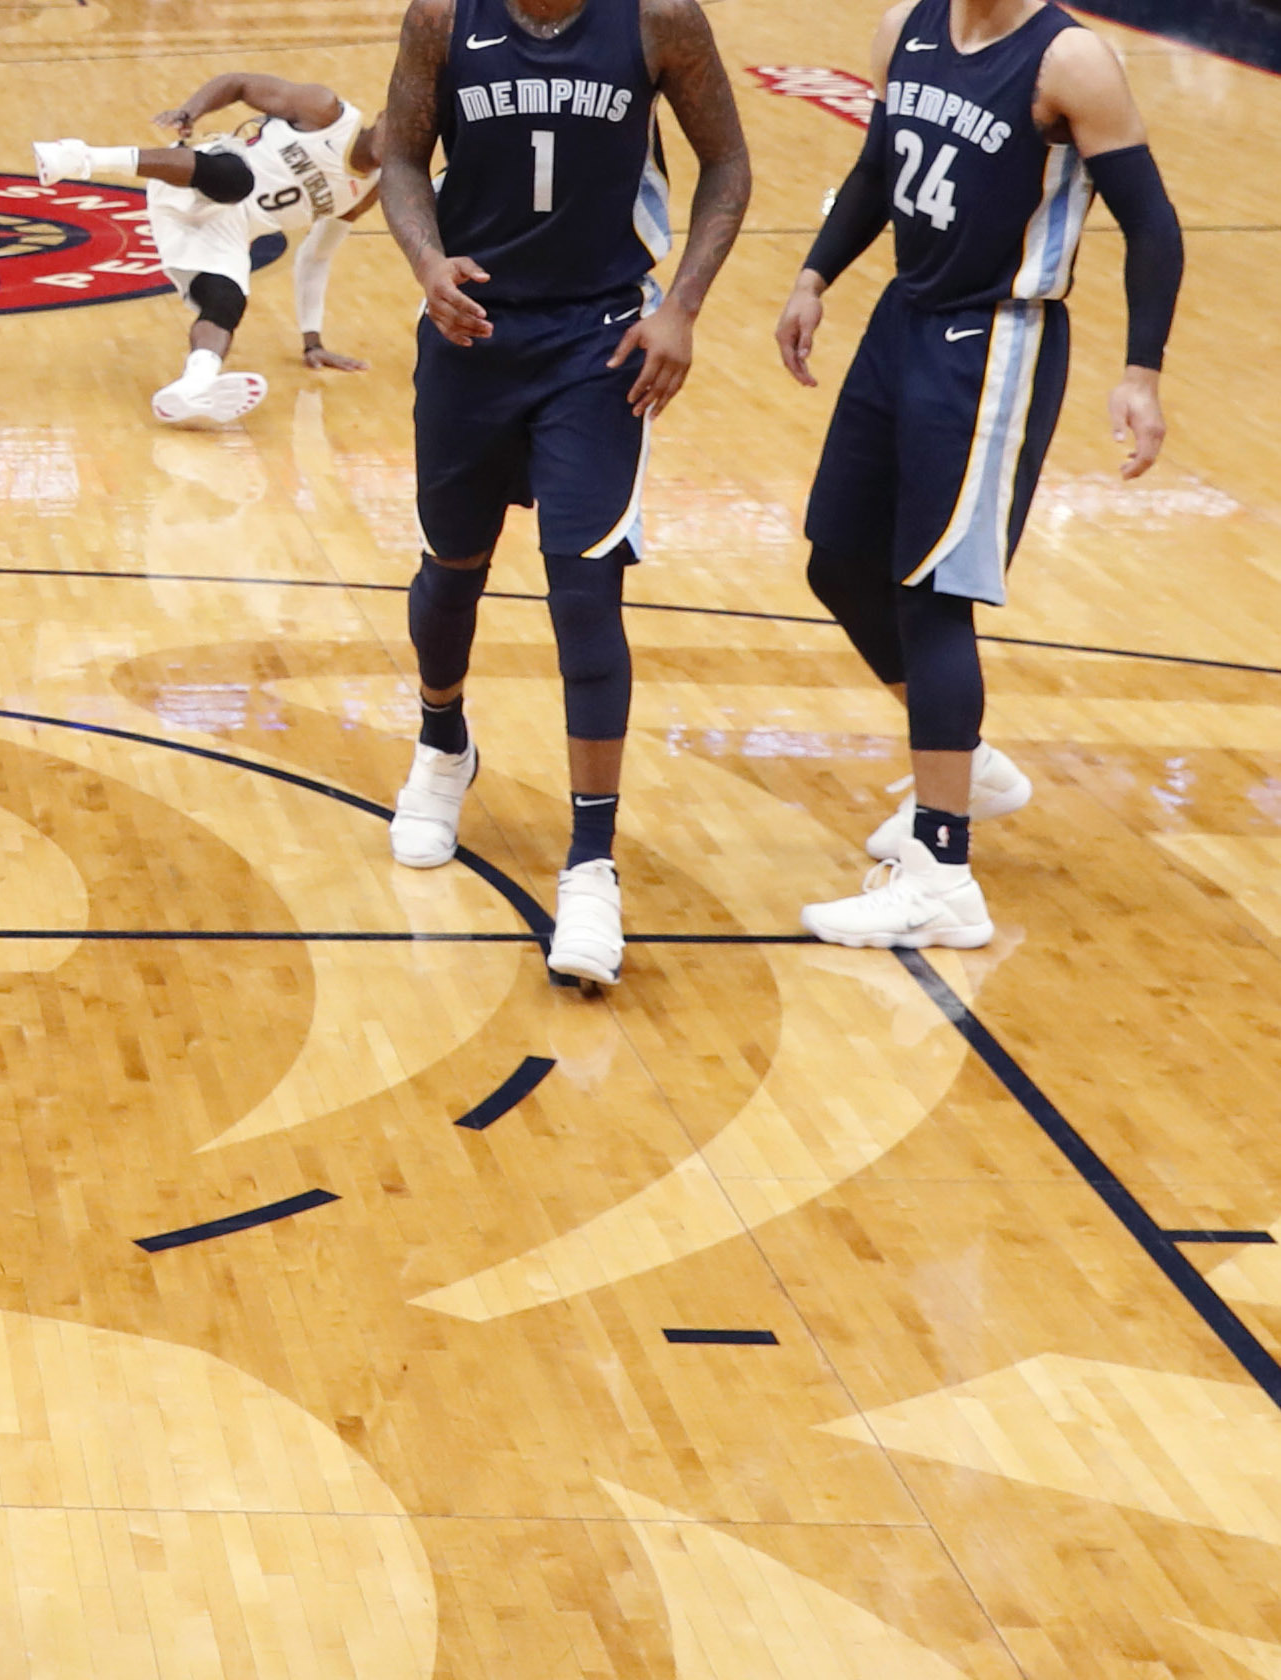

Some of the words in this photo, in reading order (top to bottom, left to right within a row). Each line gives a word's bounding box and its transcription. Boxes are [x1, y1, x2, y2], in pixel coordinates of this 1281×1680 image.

[456, 77, 634, 122] MEMPHIS
[278, 140, 318, 176] NEW
[530, 129, 555, 213] 1
[893, 128, 960, 232] 24
[257, 185, 303, 213] 9
